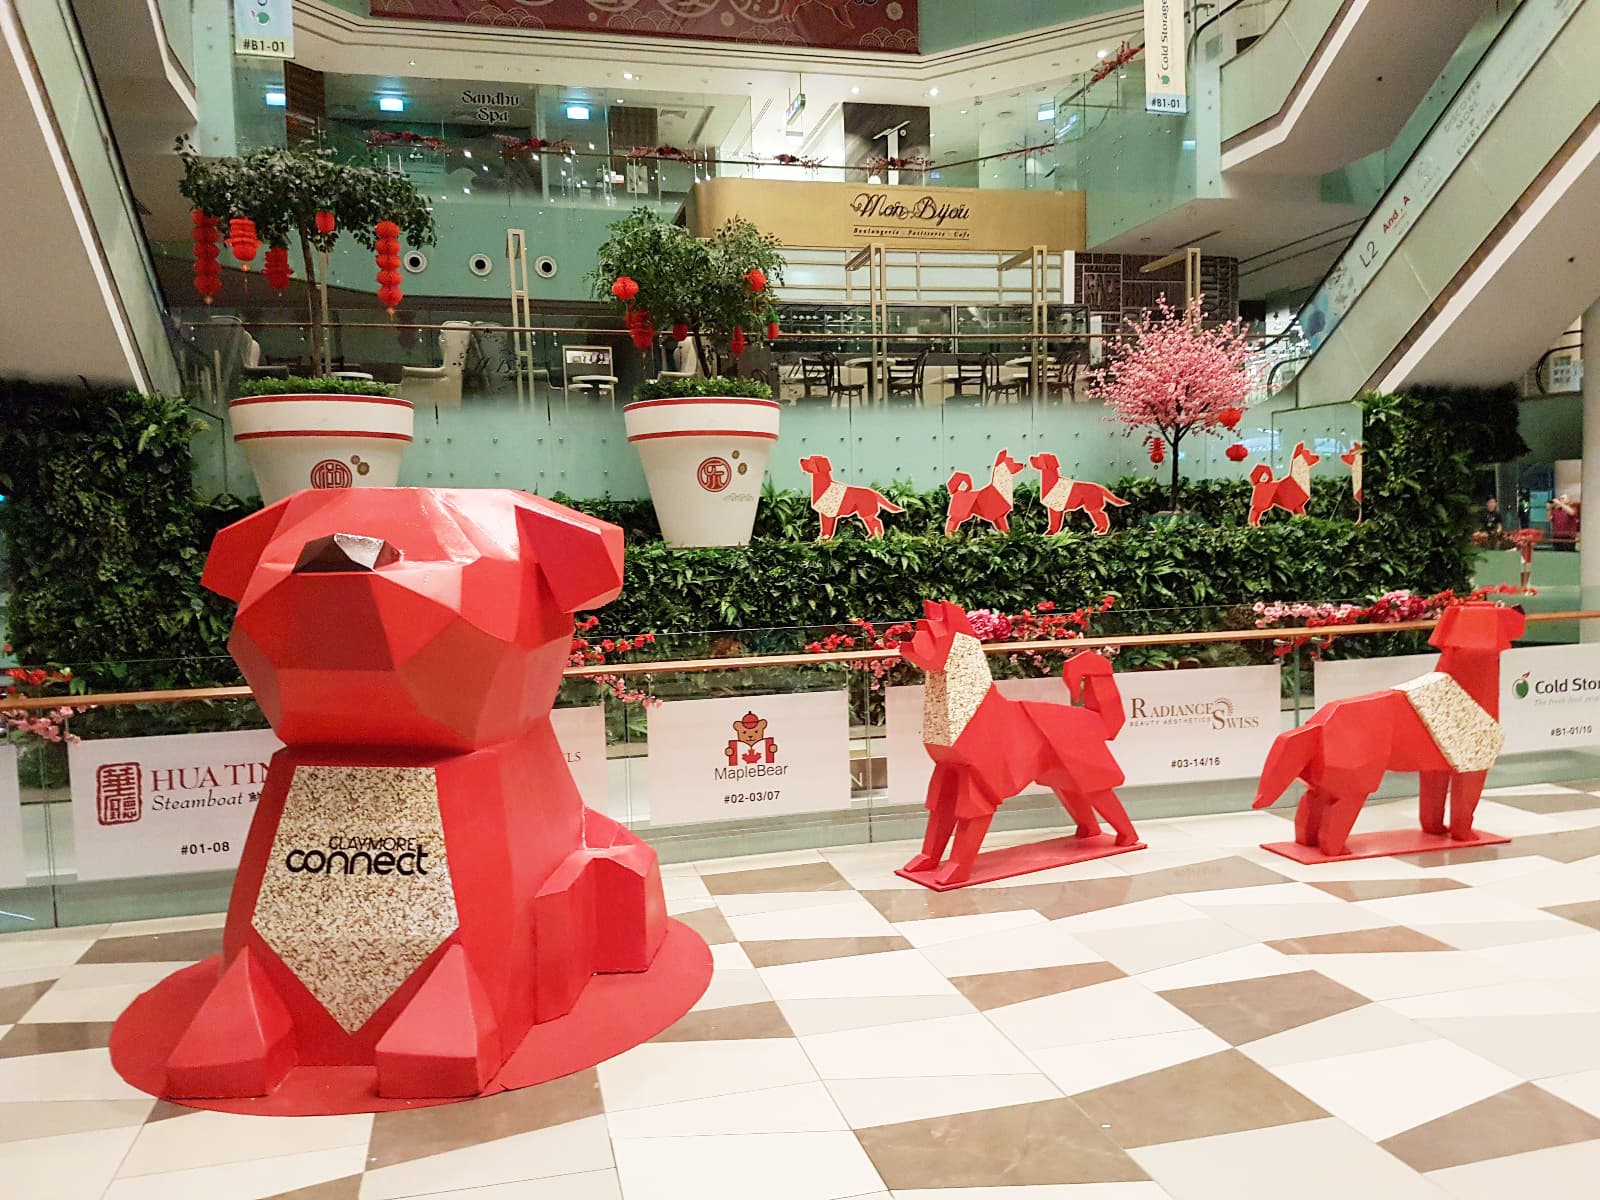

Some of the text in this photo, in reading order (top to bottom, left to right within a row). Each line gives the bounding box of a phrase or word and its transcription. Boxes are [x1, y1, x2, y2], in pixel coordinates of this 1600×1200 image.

[1160, 0, 1170, 71] Cold Storage
[243, 39, 285, 53] #B1-01
[462, 90, 519, 106] Sandhu
[1151, 98, 1180, 108] #B1-01
[478, 107, 508, 124] Spa
[1383, 209, 1399, 234] And
[1535, 677, 1600, 694] Cold Stor
[1131, 697, 1260, 730] RADIANCE SWISS
[1171, 757, 1221, 768] #03-14/16
[152, 762, 270, 792] HUA TIN
[714, 764, 789, 781] MapleBear
[152, 789, 243, 811] Steamboat
[723, 790, 781, 804] #02-03/07
[180, 841, 231, 856] #01-08
[329, 836, 417, 851] CLAYMORE
[286, 843, 428, 876] connect
